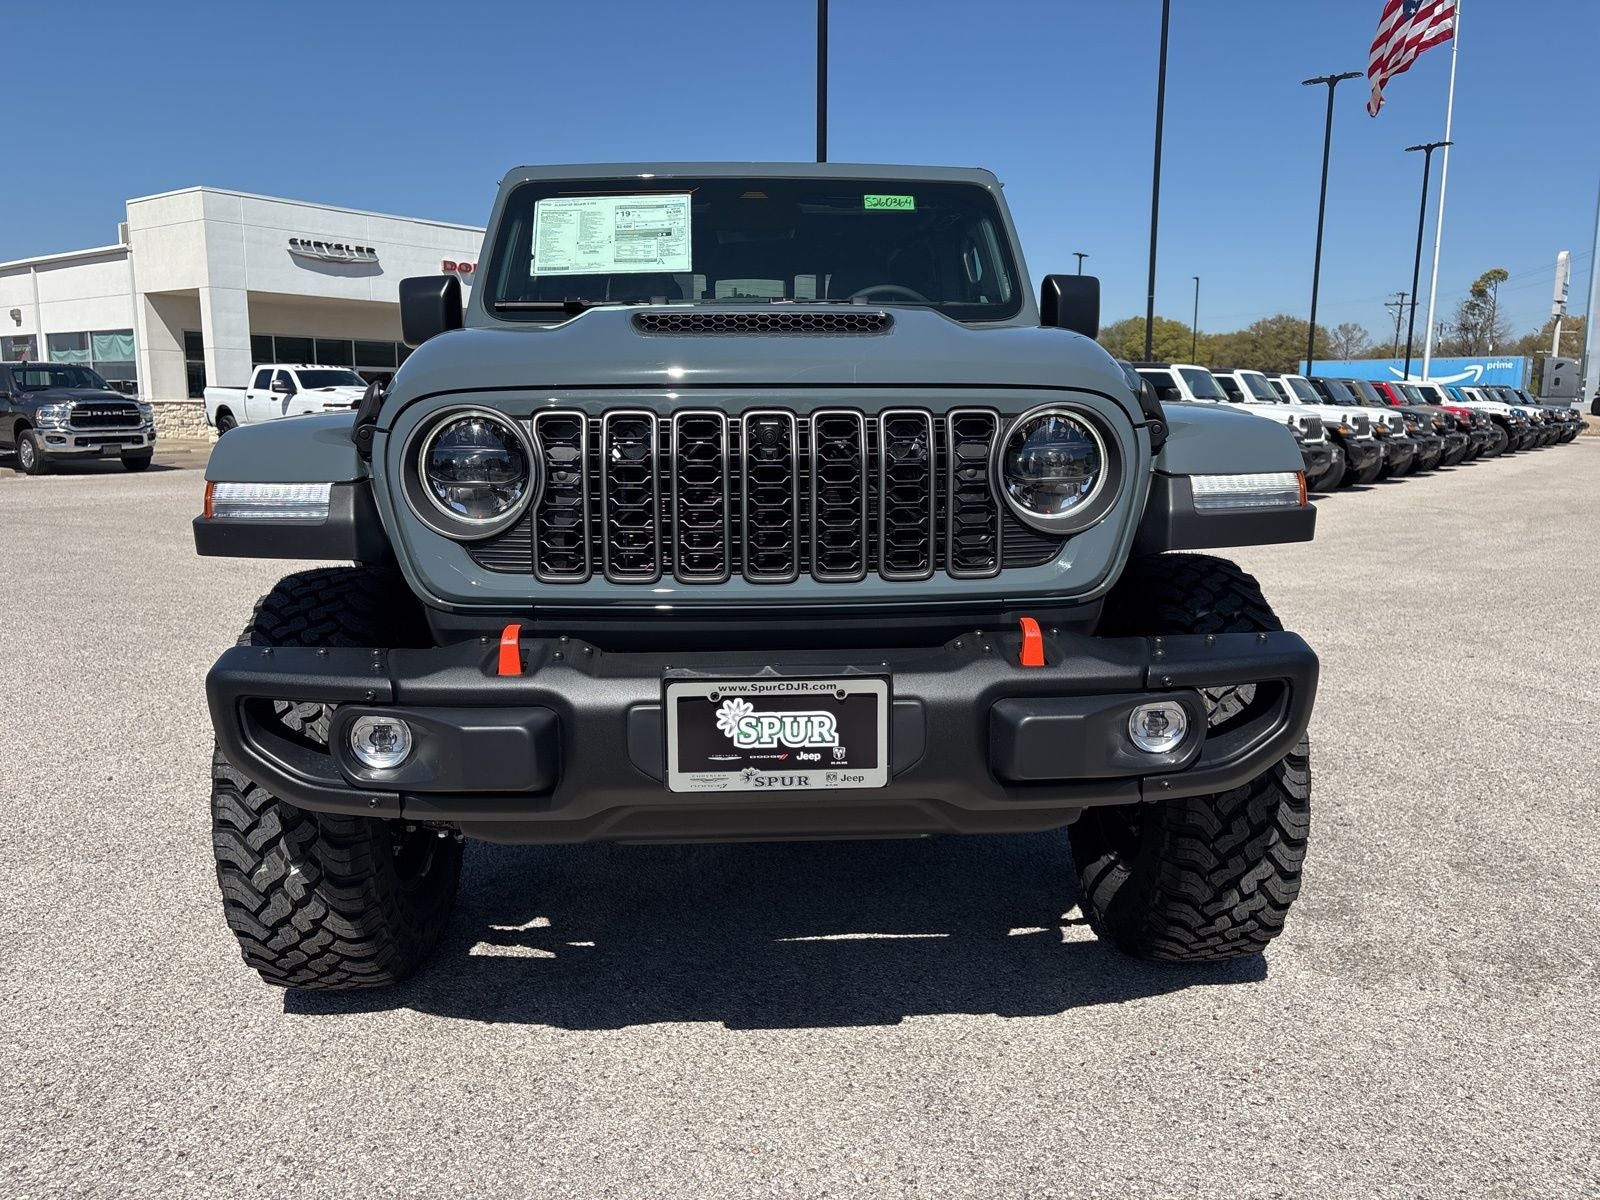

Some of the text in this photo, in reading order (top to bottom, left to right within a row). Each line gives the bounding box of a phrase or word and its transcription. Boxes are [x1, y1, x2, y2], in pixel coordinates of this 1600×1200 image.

[865, 197, 912, 208] S260364
[288, 237, 376, 254] CHRYSLER
[1486, 361, 1514, 371] prime
[718, 683, 837, 693] www.SpurCDJR.com
[736, 713, 838, 747] SPUR
[796, 751, 822, 761] Jeep
[754, 775, 810, 787] SPUR
[840, 774, 865, 783] Jeep
